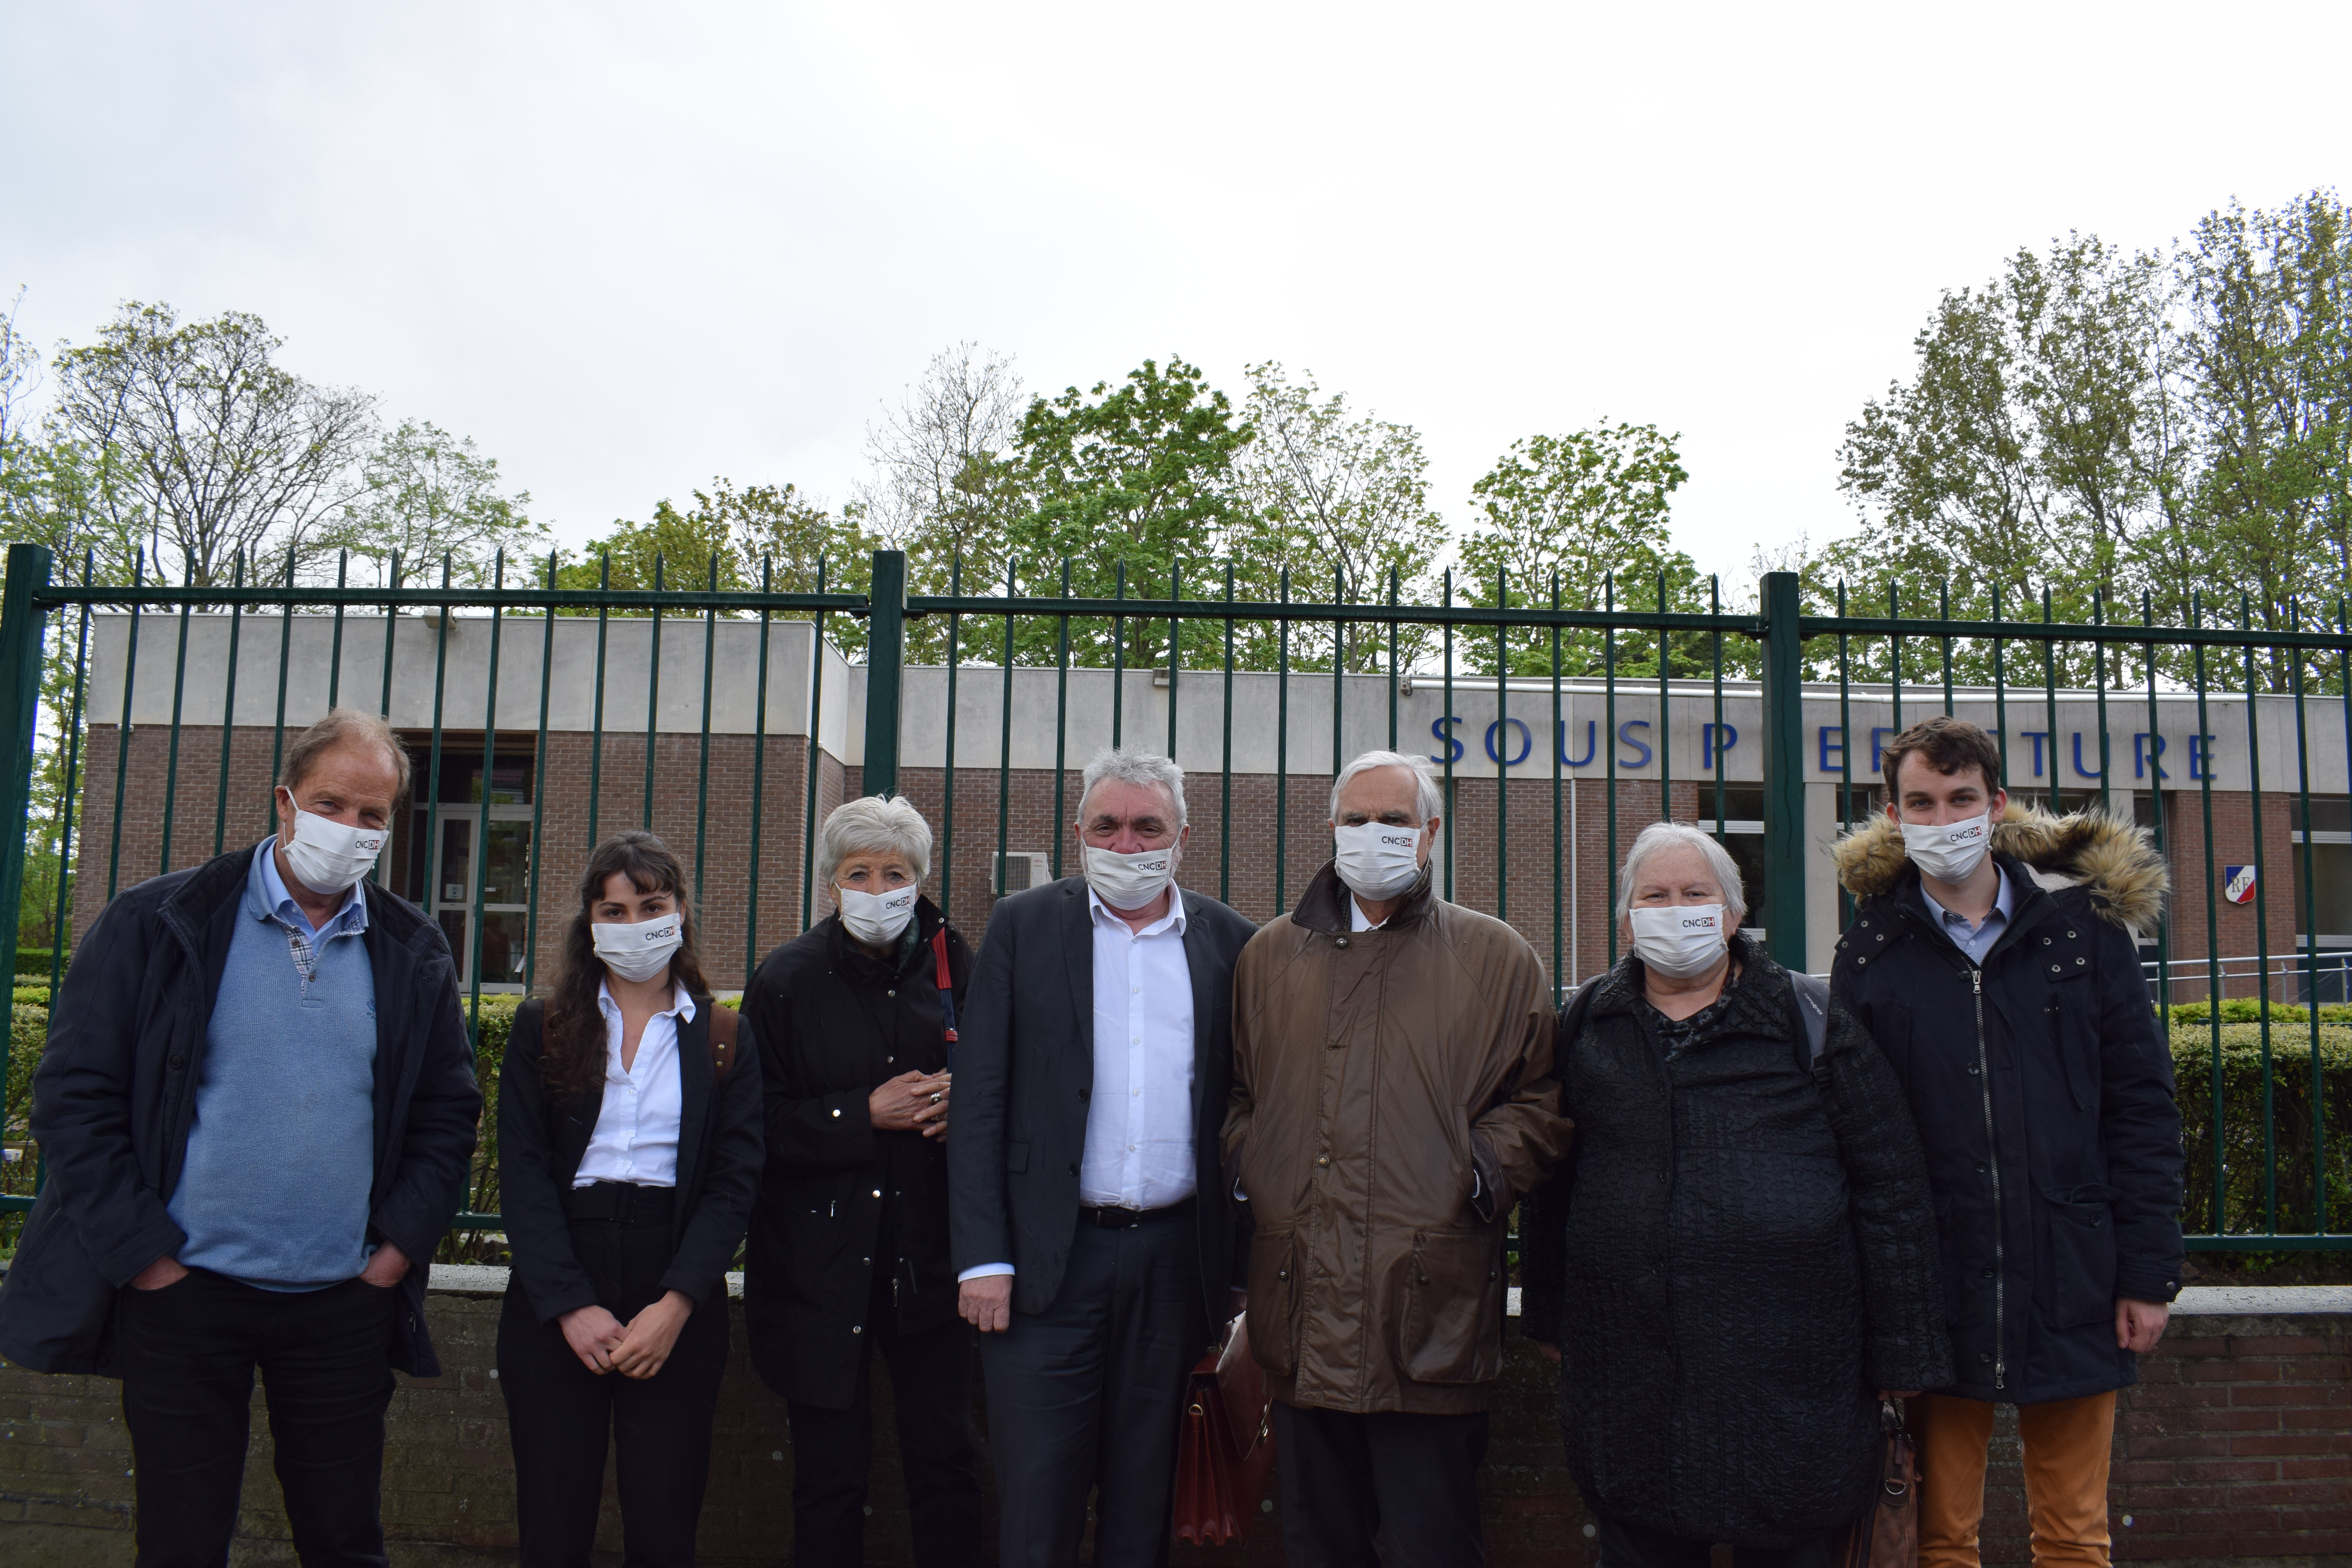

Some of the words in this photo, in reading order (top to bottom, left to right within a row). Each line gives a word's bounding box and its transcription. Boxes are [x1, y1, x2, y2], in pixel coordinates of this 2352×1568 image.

[1430, 716, 1652, 768] SOUS
[1950, 826, 1982, 842] CNCDH
[356, 840, 379, 850] CNCDH
[1381, 836, 1413, 848] CNCDH
[1138, 860, 1167, 871] CNCDH
[886, 895, 910, 909] CNCDH
[1682, 916, 1715, 927] CNCDH
[645, 926, 675, 941] CNCDH
